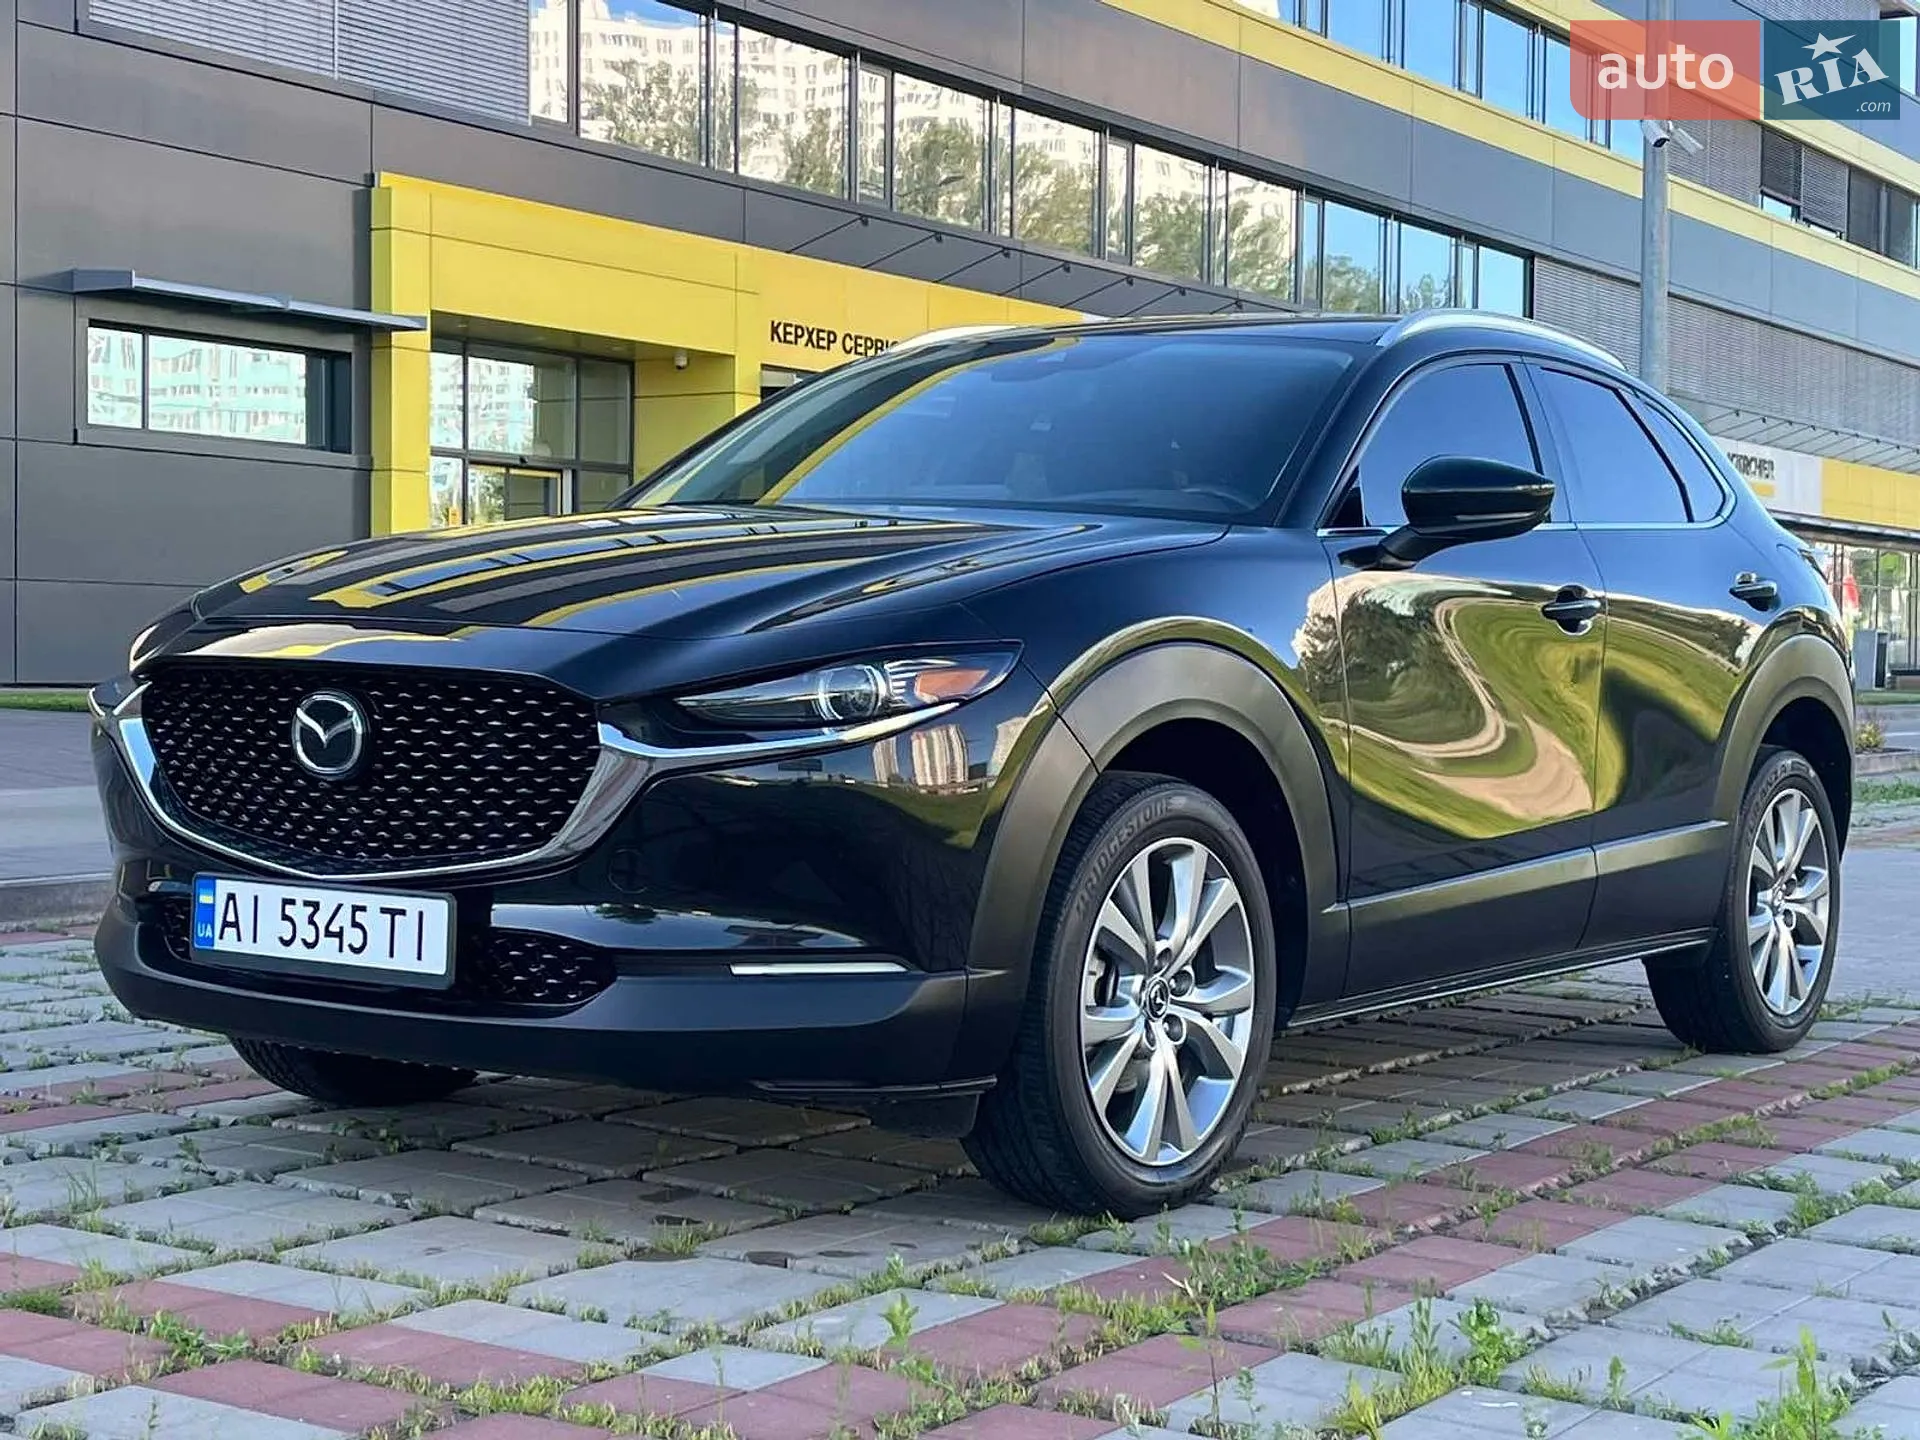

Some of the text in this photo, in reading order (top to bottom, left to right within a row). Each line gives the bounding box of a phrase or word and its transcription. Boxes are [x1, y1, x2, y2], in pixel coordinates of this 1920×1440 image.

[769, 320, 838, 351] КЕРХЕР
[196, 923, 214, 939] UA
[218, 892, 425, 962] AI 5345 TI
